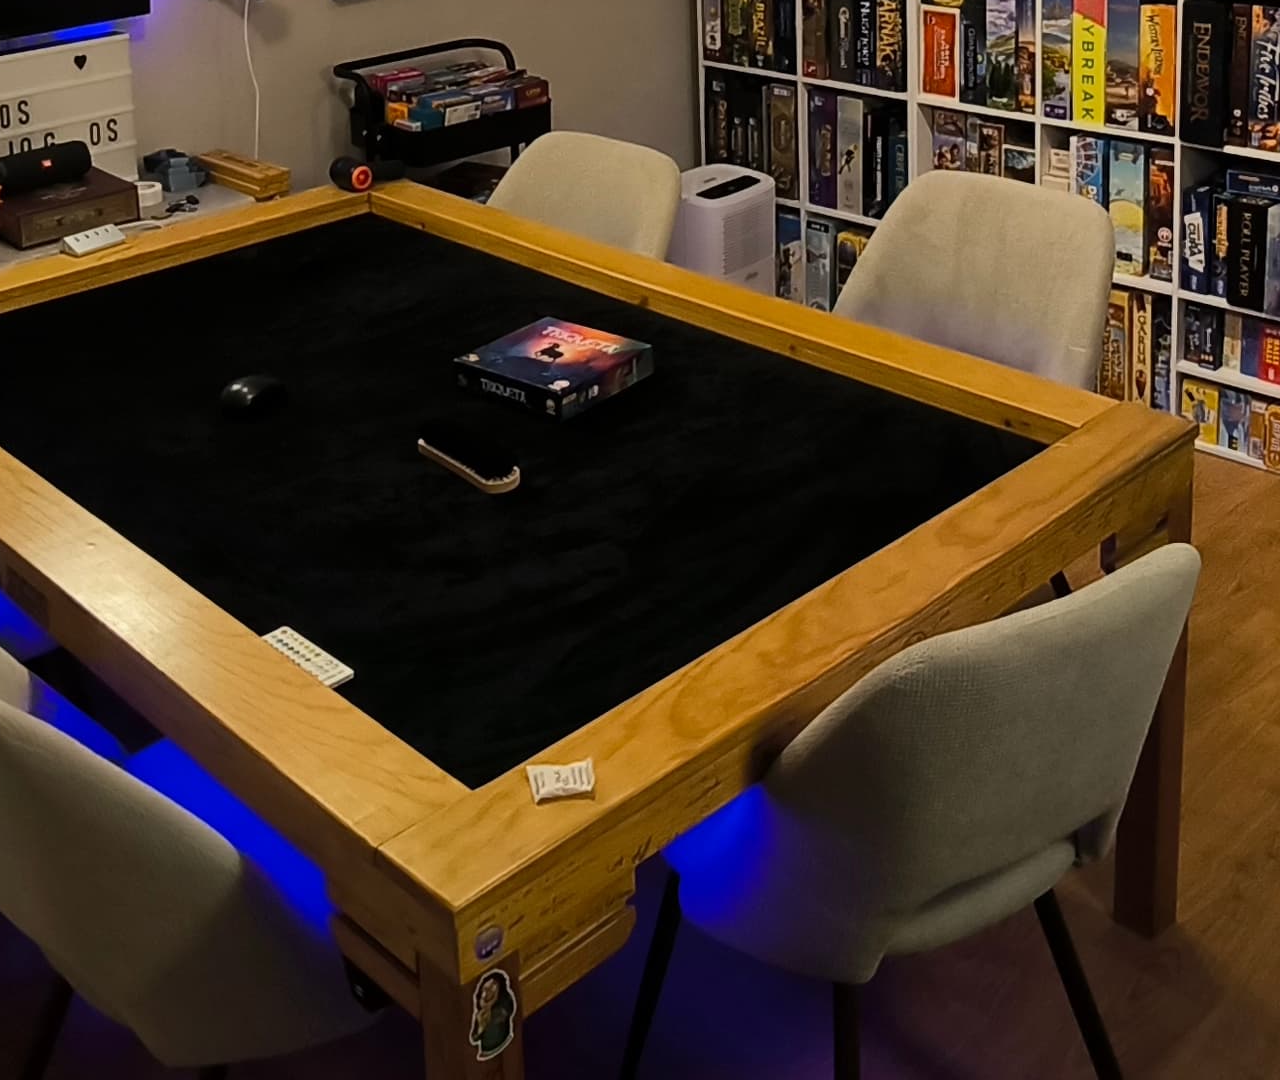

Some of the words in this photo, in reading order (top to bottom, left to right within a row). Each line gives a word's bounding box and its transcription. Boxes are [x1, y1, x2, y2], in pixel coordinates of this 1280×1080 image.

[1191, 21, 1214, 121] ENDEAVOR
[1241, 212, 1252, 246] ROLL
[1238, 249, 1251, 297] PLAYER
